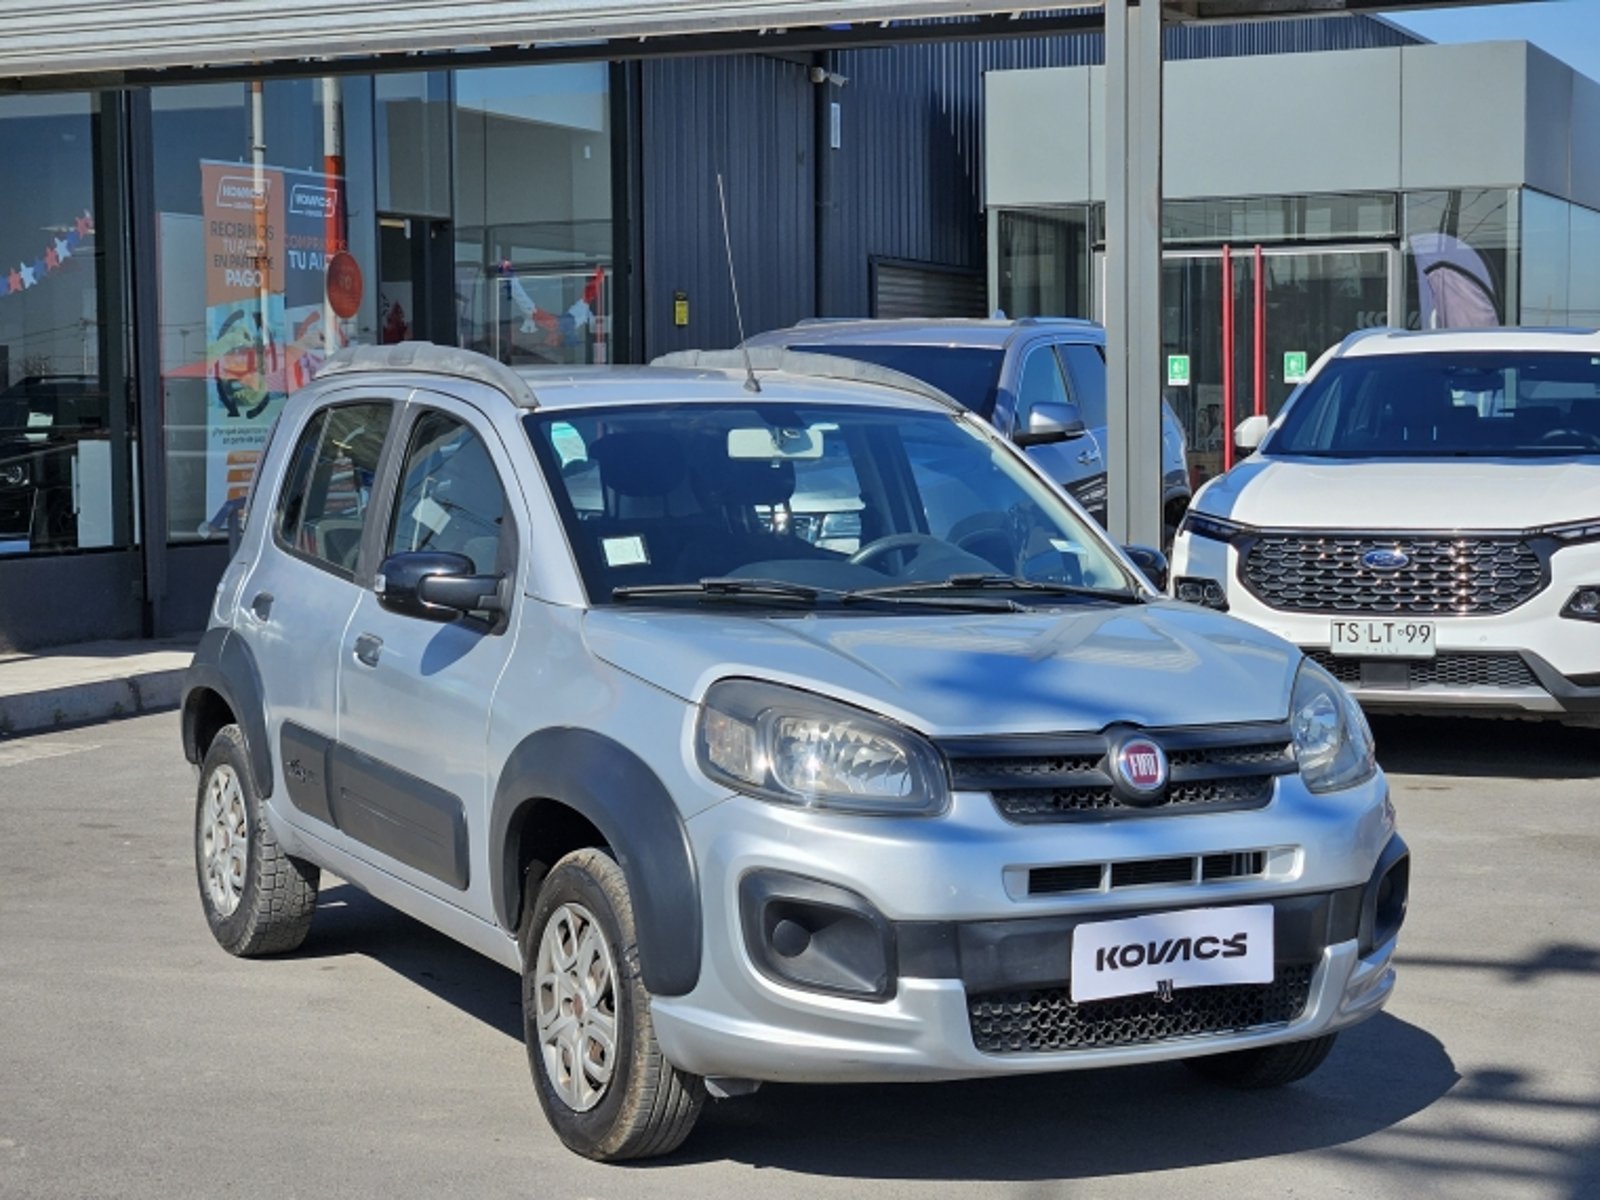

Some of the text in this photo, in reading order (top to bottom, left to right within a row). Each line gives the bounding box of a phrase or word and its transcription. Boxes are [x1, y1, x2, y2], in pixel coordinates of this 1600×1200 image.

[288, 250, 306, 270] TU
[225, 268, 263, 288] PAGO
[1128, 753, 1157, 778] FIAT
[1096, 932, 1248, 972] KOVACS
